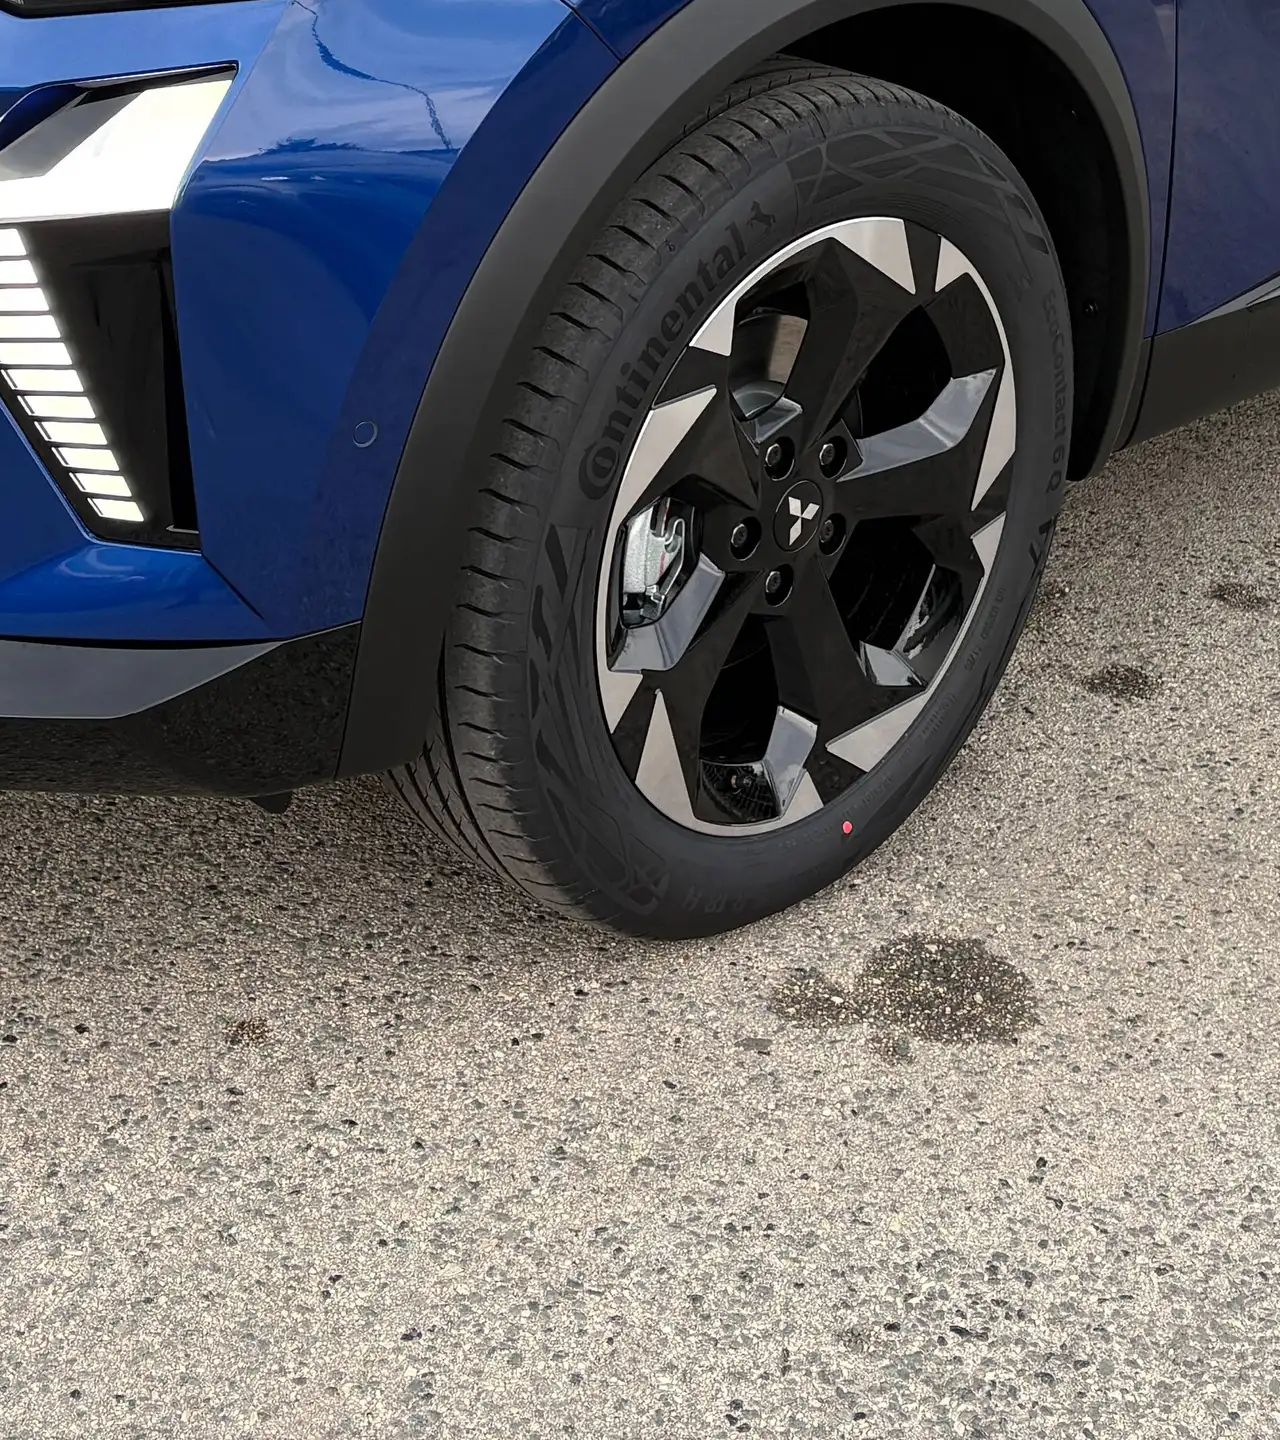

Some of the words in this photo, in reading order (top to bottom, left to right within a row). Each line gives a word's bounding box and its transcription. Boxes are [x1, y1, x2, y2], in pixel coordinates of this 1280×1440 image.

[578, 220, 748, 500] Continental
[1041, 288, 1069, 440] EcoContact
[1050, 445, 1066, 464] 6
